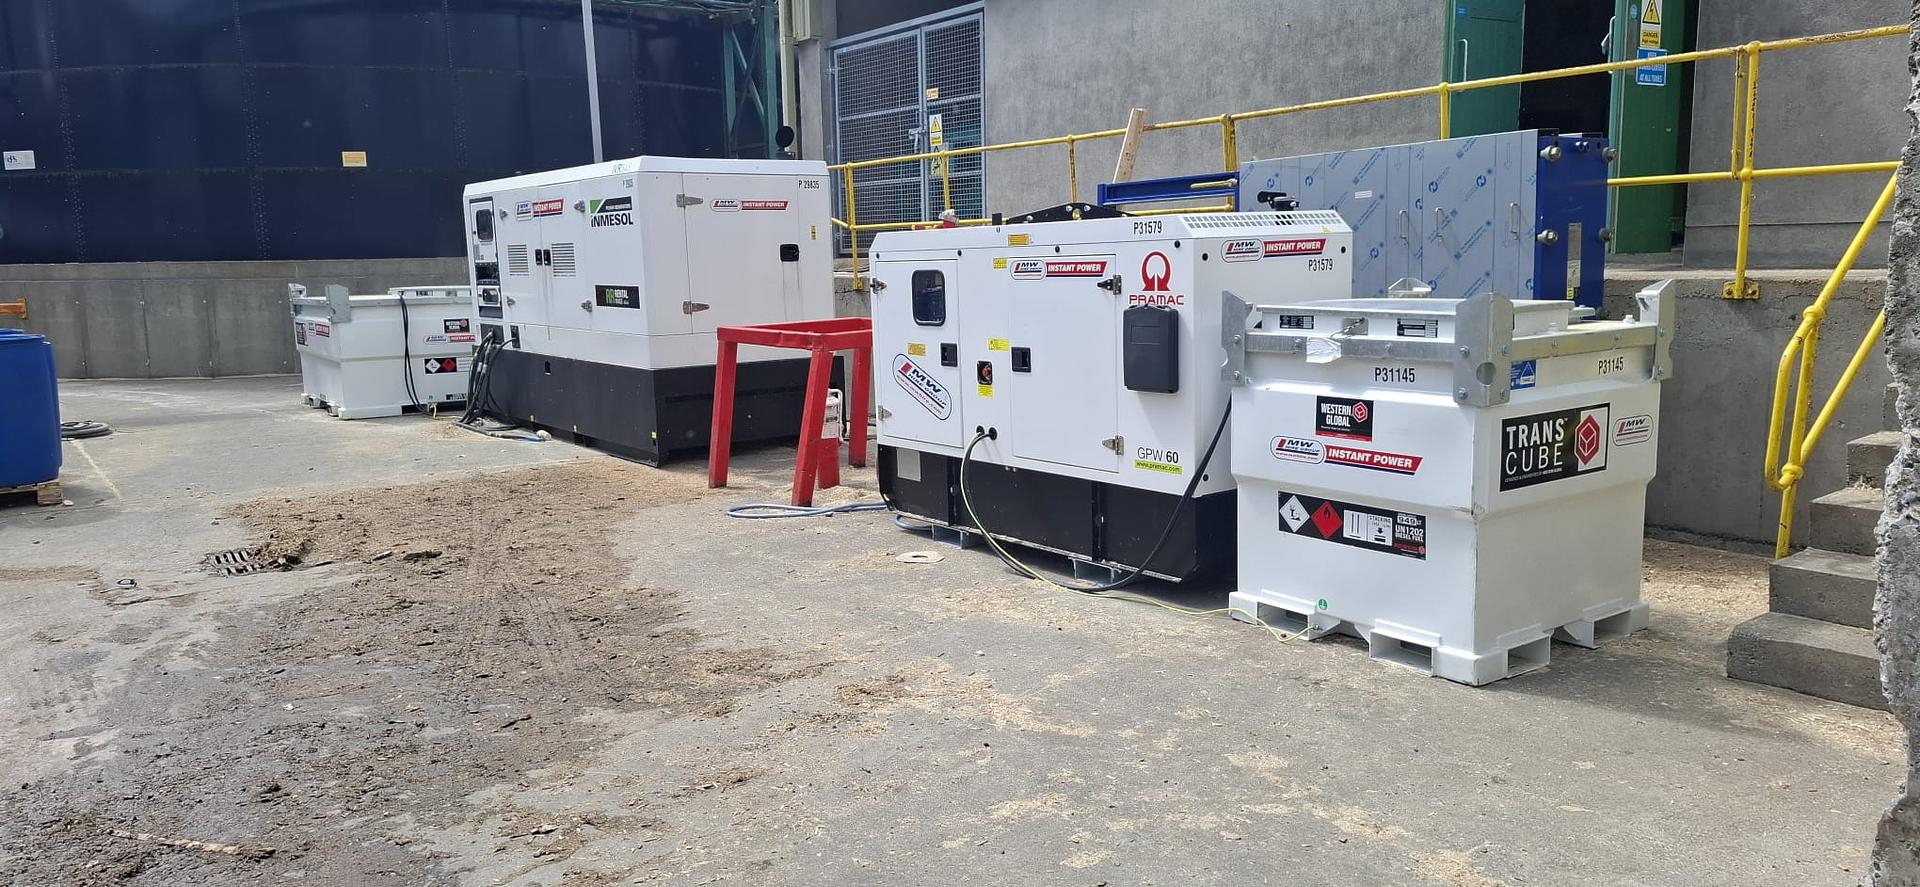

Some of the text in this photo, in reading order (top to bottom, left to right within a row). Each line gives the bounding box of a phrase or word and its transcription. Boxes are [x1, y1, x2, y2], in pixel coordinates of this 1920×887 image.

[1133, 221, 1162, 234] P31579
[1265, 241, 1321, 252] INSTANT POWER
[1048, 264, 1075, 272] INSTANT
[1076, 264, 1101, 272] POWER
[1308, 258, 1334, 272] P31579
[1129, 294, 1184, 306] PRAMAC
[1598, 356, 1624, 375] P31145
[911, 368, 942, 393] MW
[1374, 367, 1416, 383] P31145
[1321, 403, 1352, 416] WESTERN
[1326, 415, 1351, 427] GLOBAL
[1626, 418, 1646, 427] MW
[1287, 440, 1314, 448] MW
[1137, 446, 1179, 464] GPW 60
[1328, 448, 1413, 468] INSTANT POWER
[1506, 442, 1564, 475] CUBE
